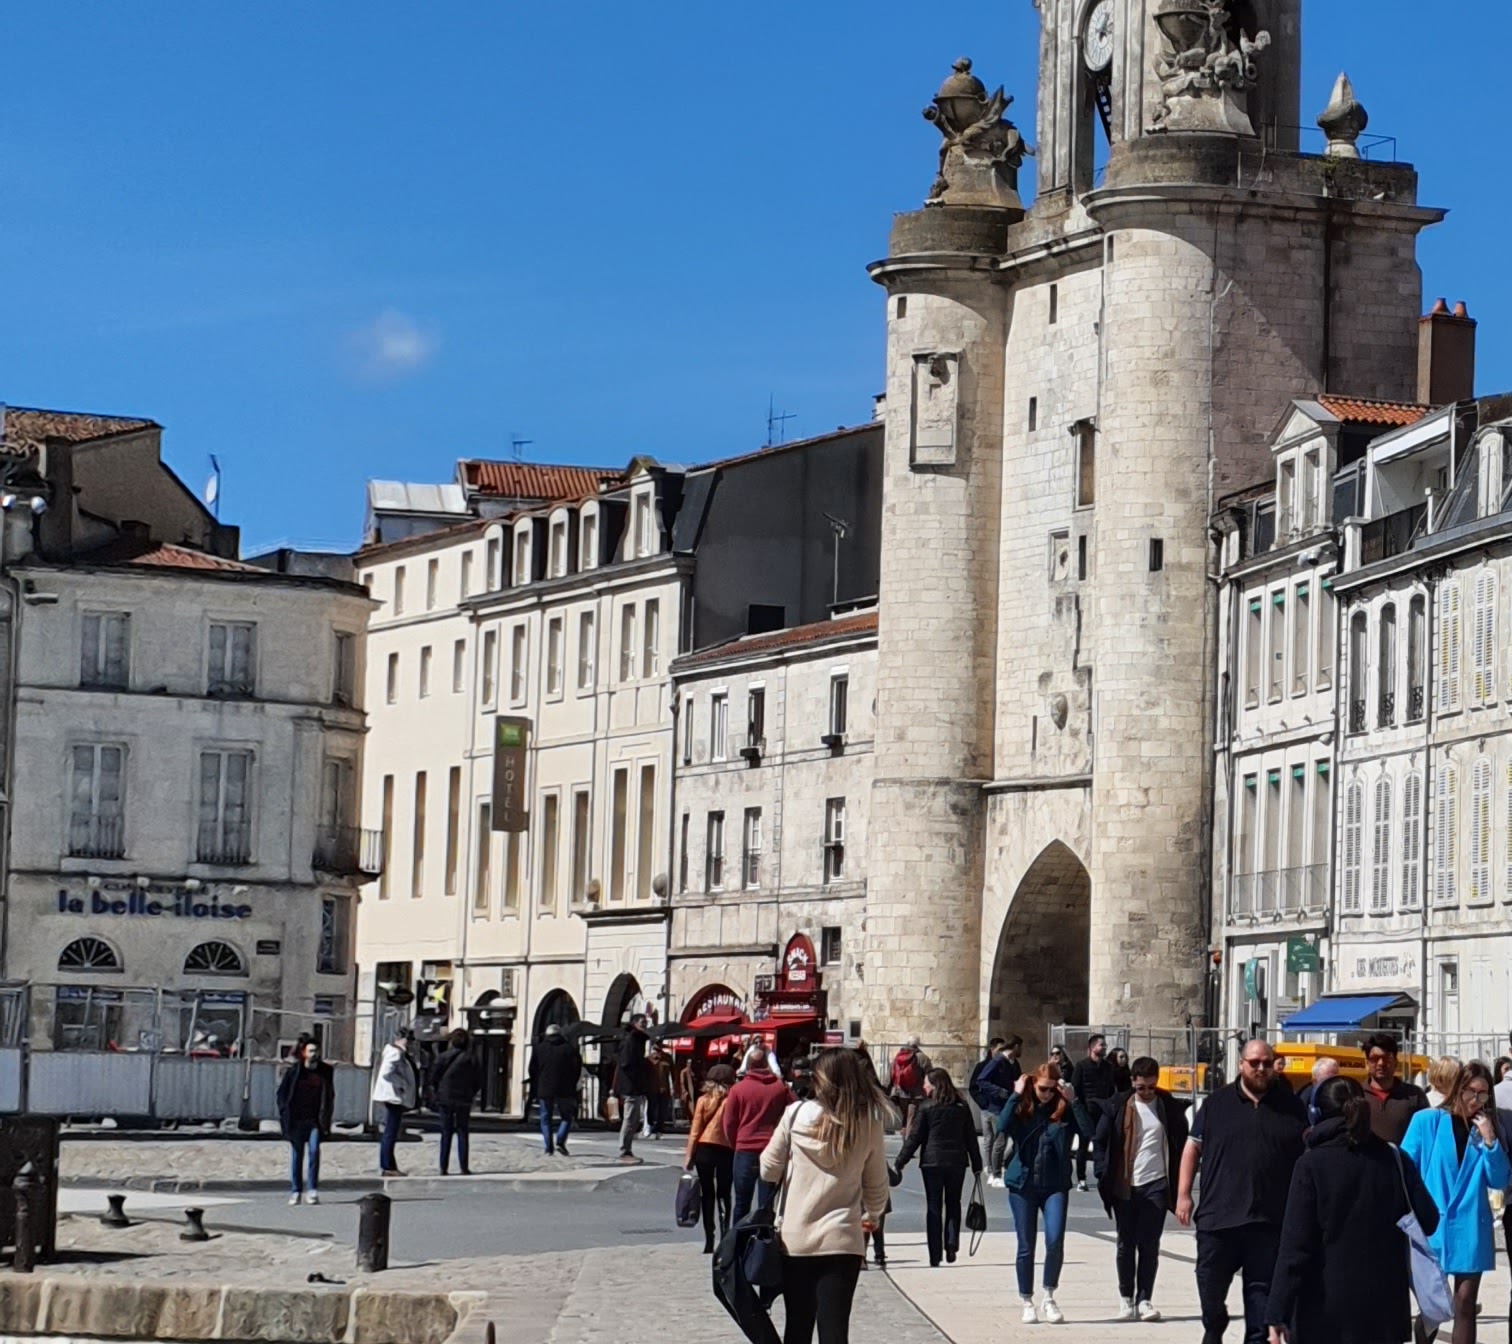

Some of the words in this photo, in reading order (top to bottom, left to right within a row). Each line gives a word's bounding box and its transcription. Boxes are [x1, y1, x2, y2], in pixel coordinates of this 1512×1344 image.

[504, 756, 516, 822] HOTEL
[58, 889, 84, 913] la
[696, 994, 749, 1018] RESTAURAN
